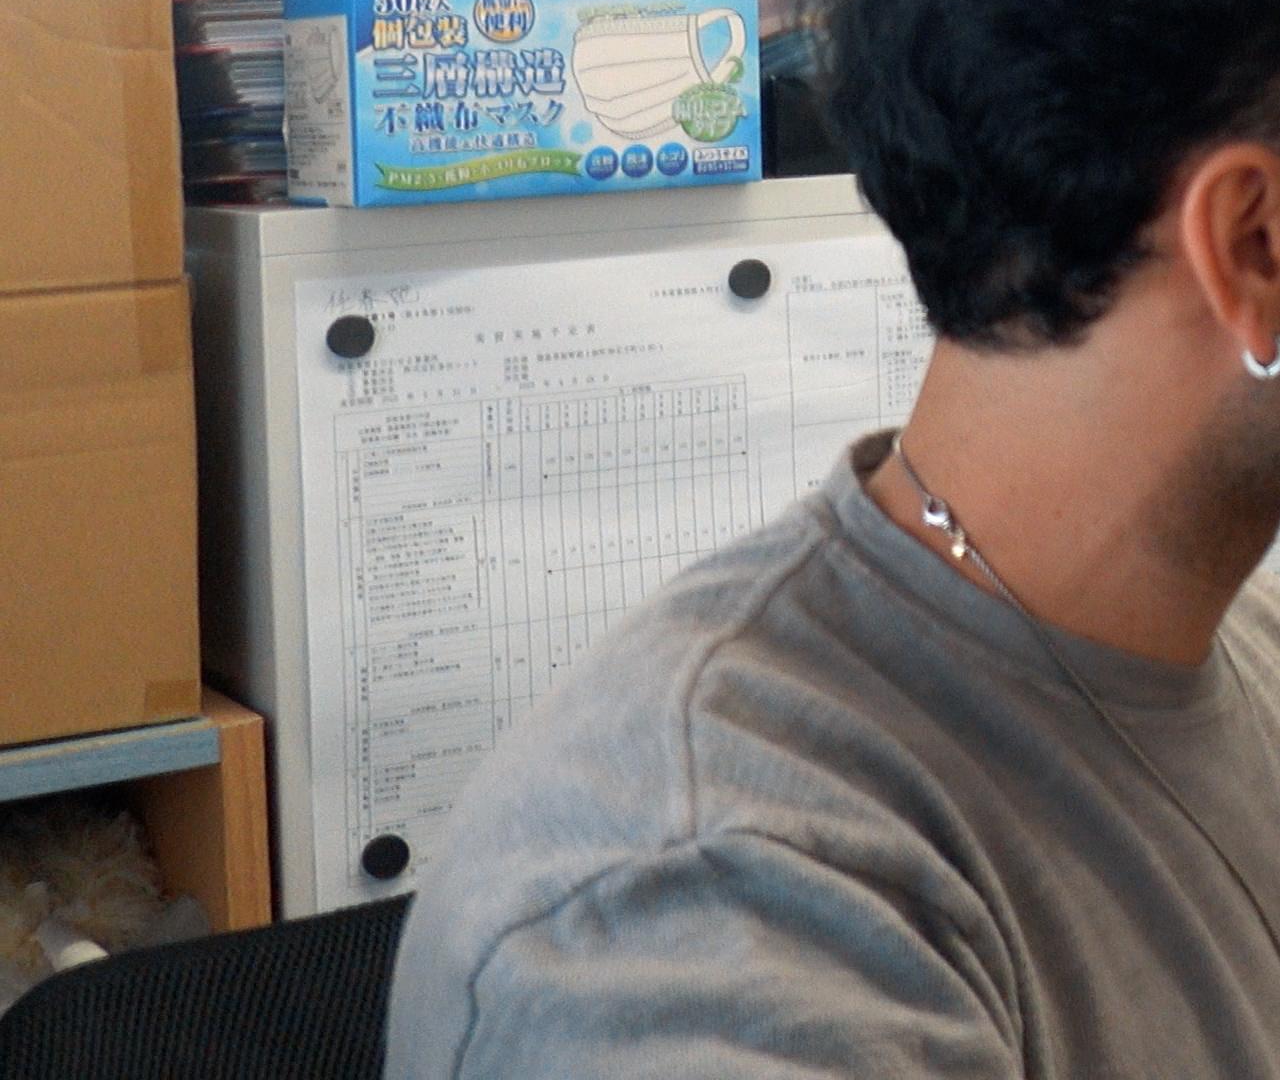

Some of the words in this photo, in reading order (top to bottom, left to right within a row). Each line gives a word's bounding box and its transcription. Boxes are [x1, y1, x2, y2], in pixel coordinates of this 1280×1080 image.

[372, 16, 468, 51] 個包装
[373, 48, 566, 99] 三層構造
[375, 100, 566, 135] 不織布マスク
